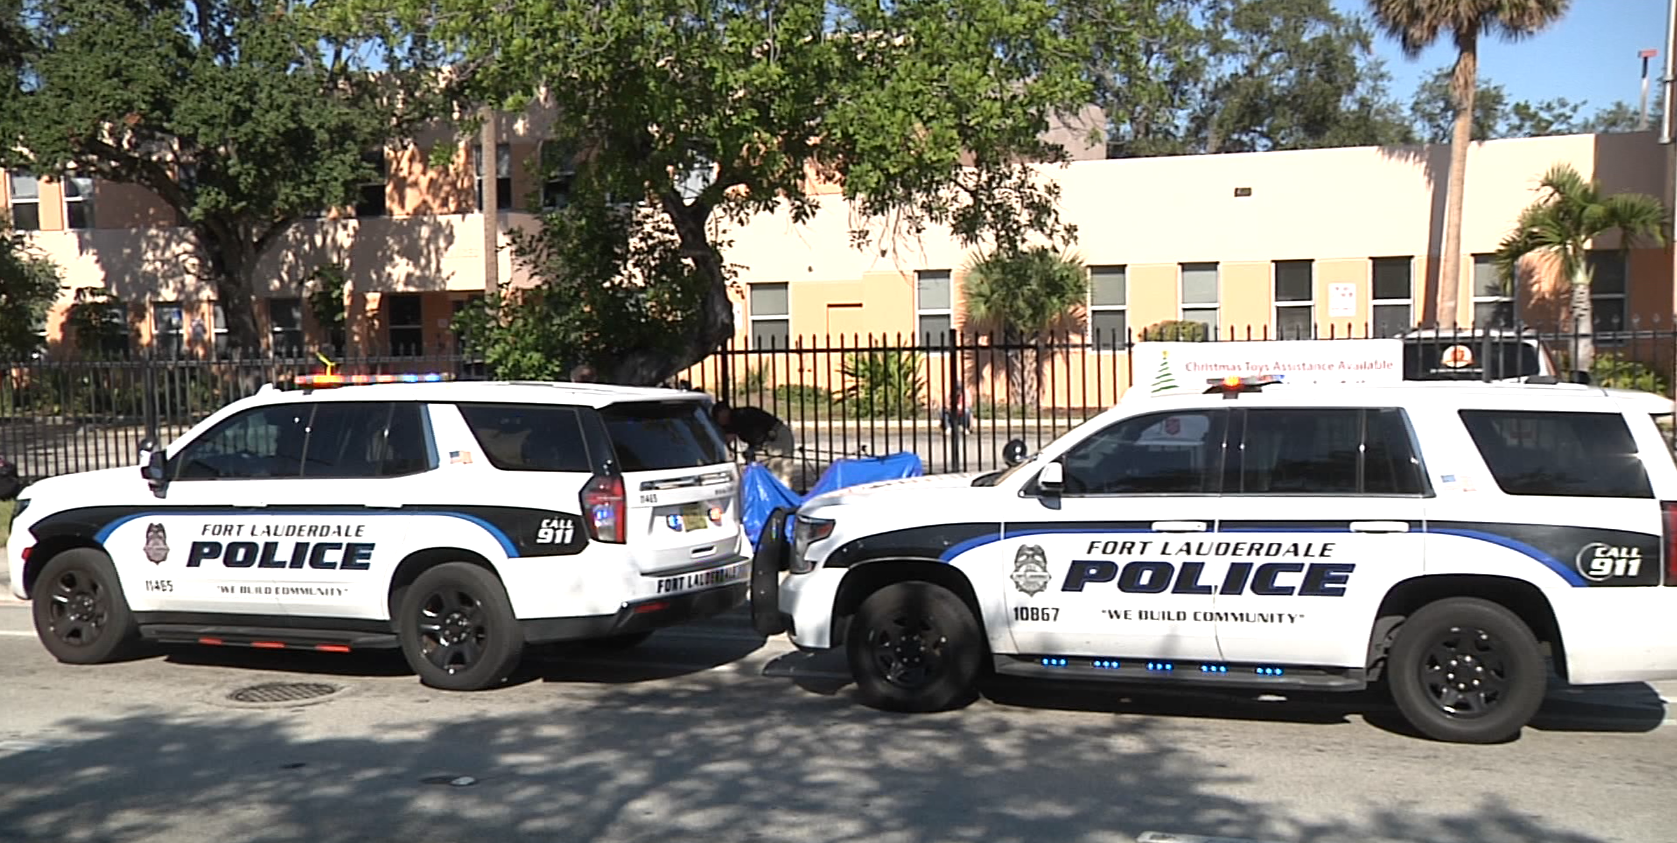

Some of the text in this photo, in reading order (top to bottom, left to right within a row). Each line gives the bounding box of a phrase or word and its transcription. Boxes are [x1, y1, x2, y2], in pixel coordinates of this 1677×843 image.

[1185, 359, 1394, 375] Christmas Toys Assistance Available
[201, 524, 365, 538] FORT LAUDERDALE
[541, 518, 574, 529] CALL
[536, 528, 574, 544] 911
[186, 541, 376, 570] POLICE
[1086, 540, 1336, 558] FORT LAUDERDALE
[1595, 547, 1642, 558] CALL
[1588, 558, 1642, 576] 911
[657, 576, 685, 593] FORT
[1061, 560, 1357, 597] POLICE
[240, 586, 272, 595] BUILD
[1013, 606, 1060, 622] 10867
[1101, 609, 1305, 624] "WE BUILD COMMUNITY"
